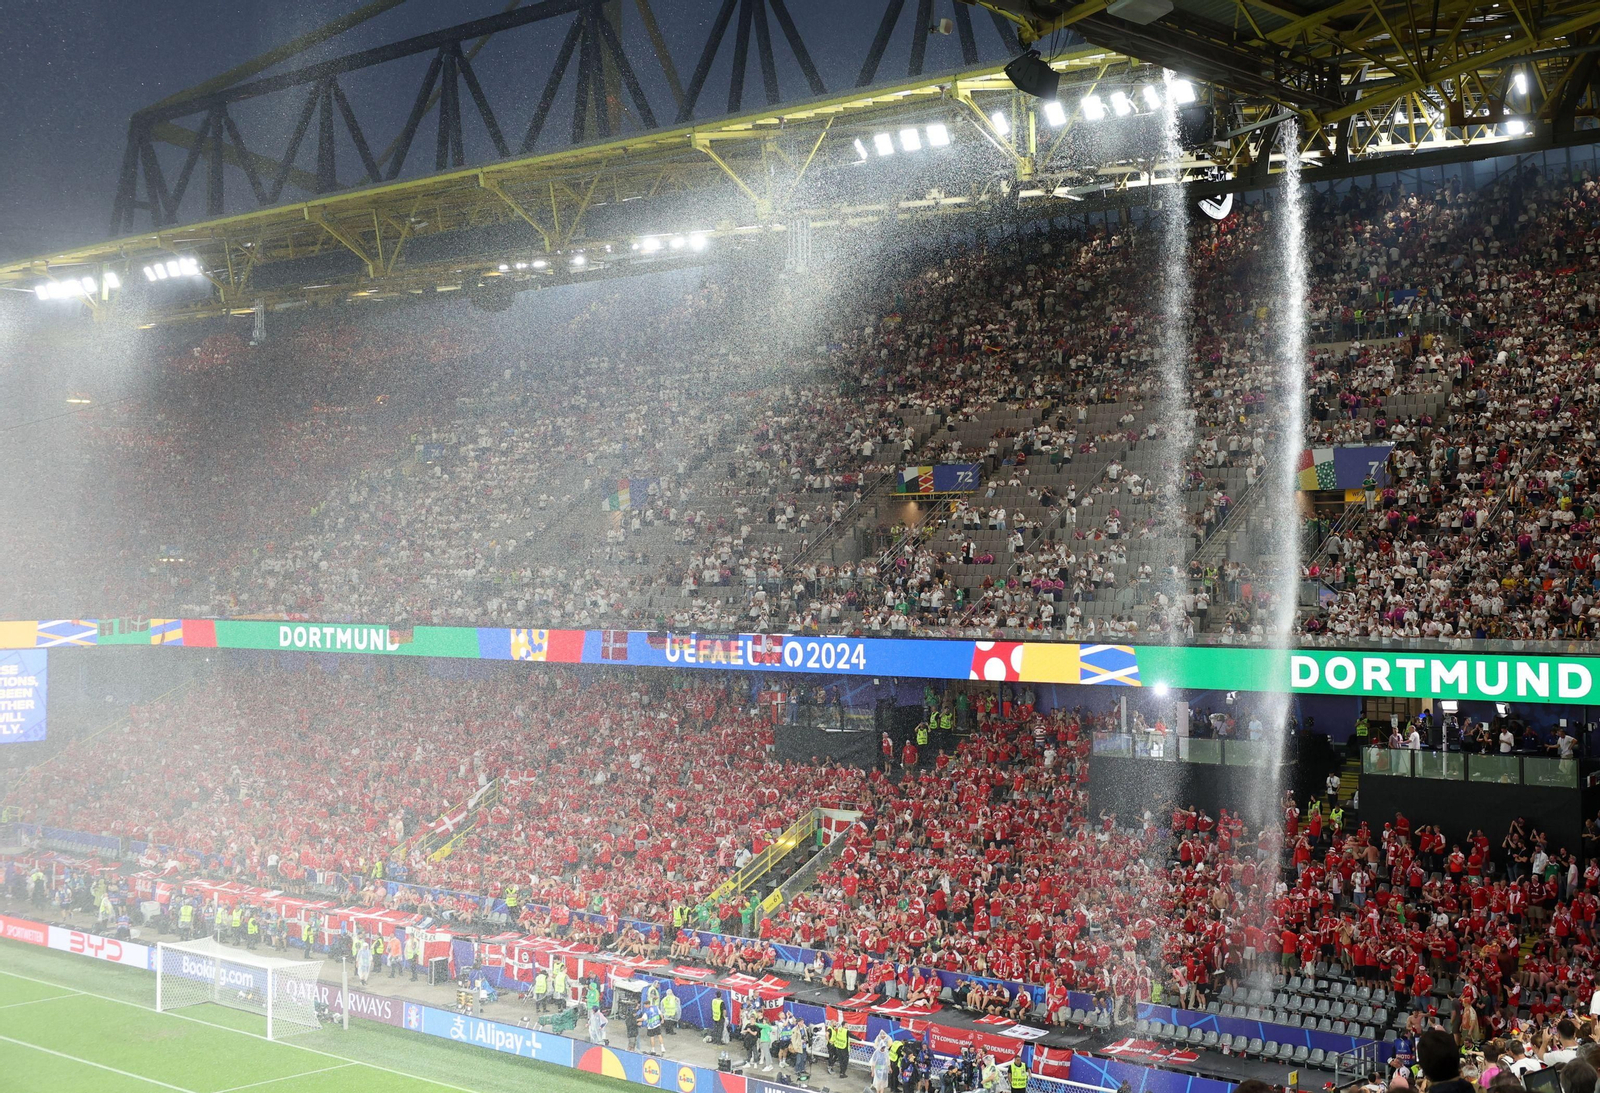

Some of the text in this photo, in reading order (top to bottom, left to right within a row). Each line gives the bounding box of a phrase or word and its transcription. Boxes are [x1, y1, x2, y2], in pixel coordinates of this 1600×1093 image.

[957, 472, 973, 482] 72
[279, 626, 400, 651] DORTMUND
[731, 640, 803, 668] EUO
[807, 642, 866, 670] 2024
[0, 665, 18, 675] SE
[1291, 655, 1592, 698] DORTMUND
[70, 931, 123, 961] BYD
[286, 979, 392, 1019] QATAR ARWAYS
[991, 1045, 1015, 1055] DENMARK
